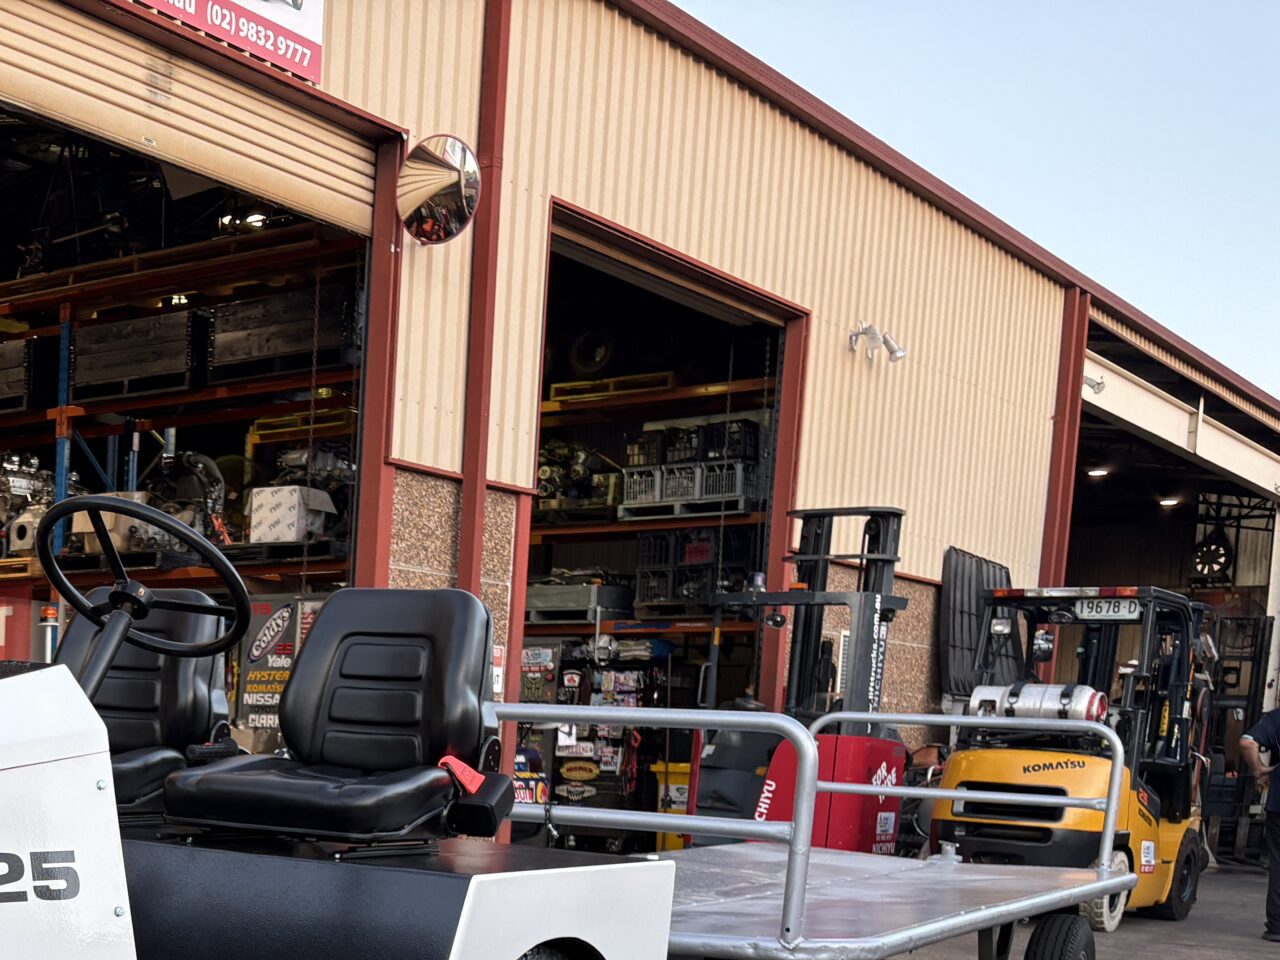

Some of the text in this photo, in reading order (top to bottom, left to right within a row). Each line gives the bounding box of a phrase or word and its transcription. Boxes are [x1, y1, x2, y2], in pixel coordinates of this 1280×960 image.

[207, 1, 312, 67] (02) 9832 9777
[267, 654, 292, 668] Yale
[247, 671, 290, 681] HYSTER
[243, 693, 280, 704] NISSA
[1022, 758, 1086, 774] KOMATSU
